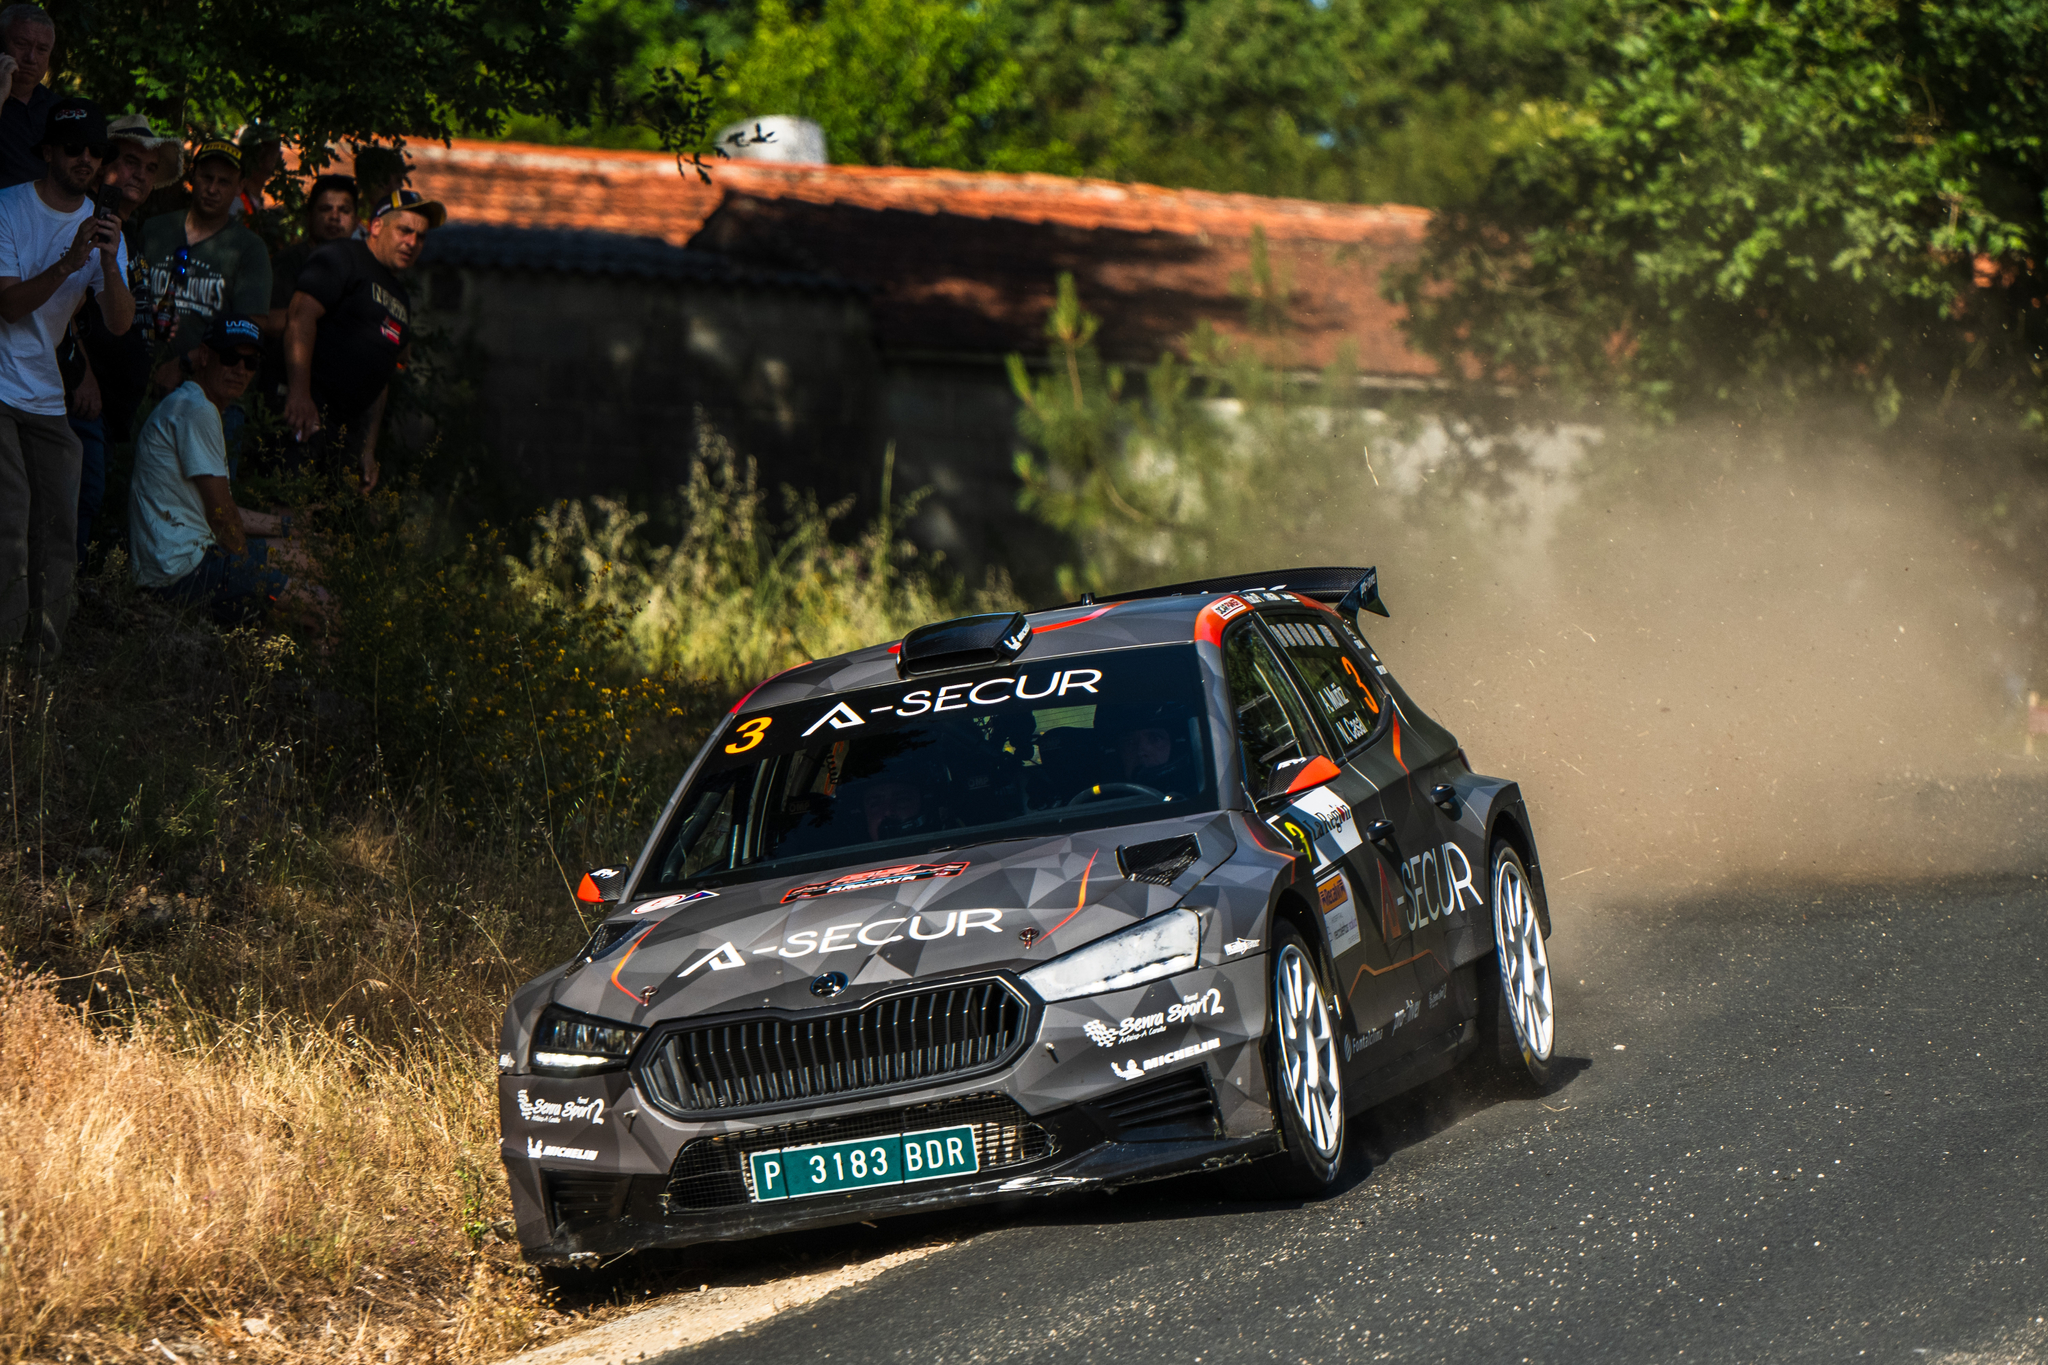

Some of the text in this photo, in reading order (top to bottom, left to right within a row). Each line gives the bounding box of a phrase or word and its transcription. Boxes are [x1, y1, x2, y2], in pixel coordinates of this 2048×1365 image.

[183, 277, 226, 311] JONES
[225, 319, 260, 335] WRC
[801, 668, 1103, 737] A-SECUR
[1341, 656, 1380, 714] 3
[725, 716, 773, 755] 3
[1376, 841, 1484, 945] A-SECUR
[677, 908, 1004, 979] A-SECUR
[1118, 1011, 1165, 1037] Senra
[1142, 1037, 1221, 1071] MICHELIN
[541, 1144, 600, 1162] MICHELIN
[763, 1136, 966, 1190] P 3183 BDR
